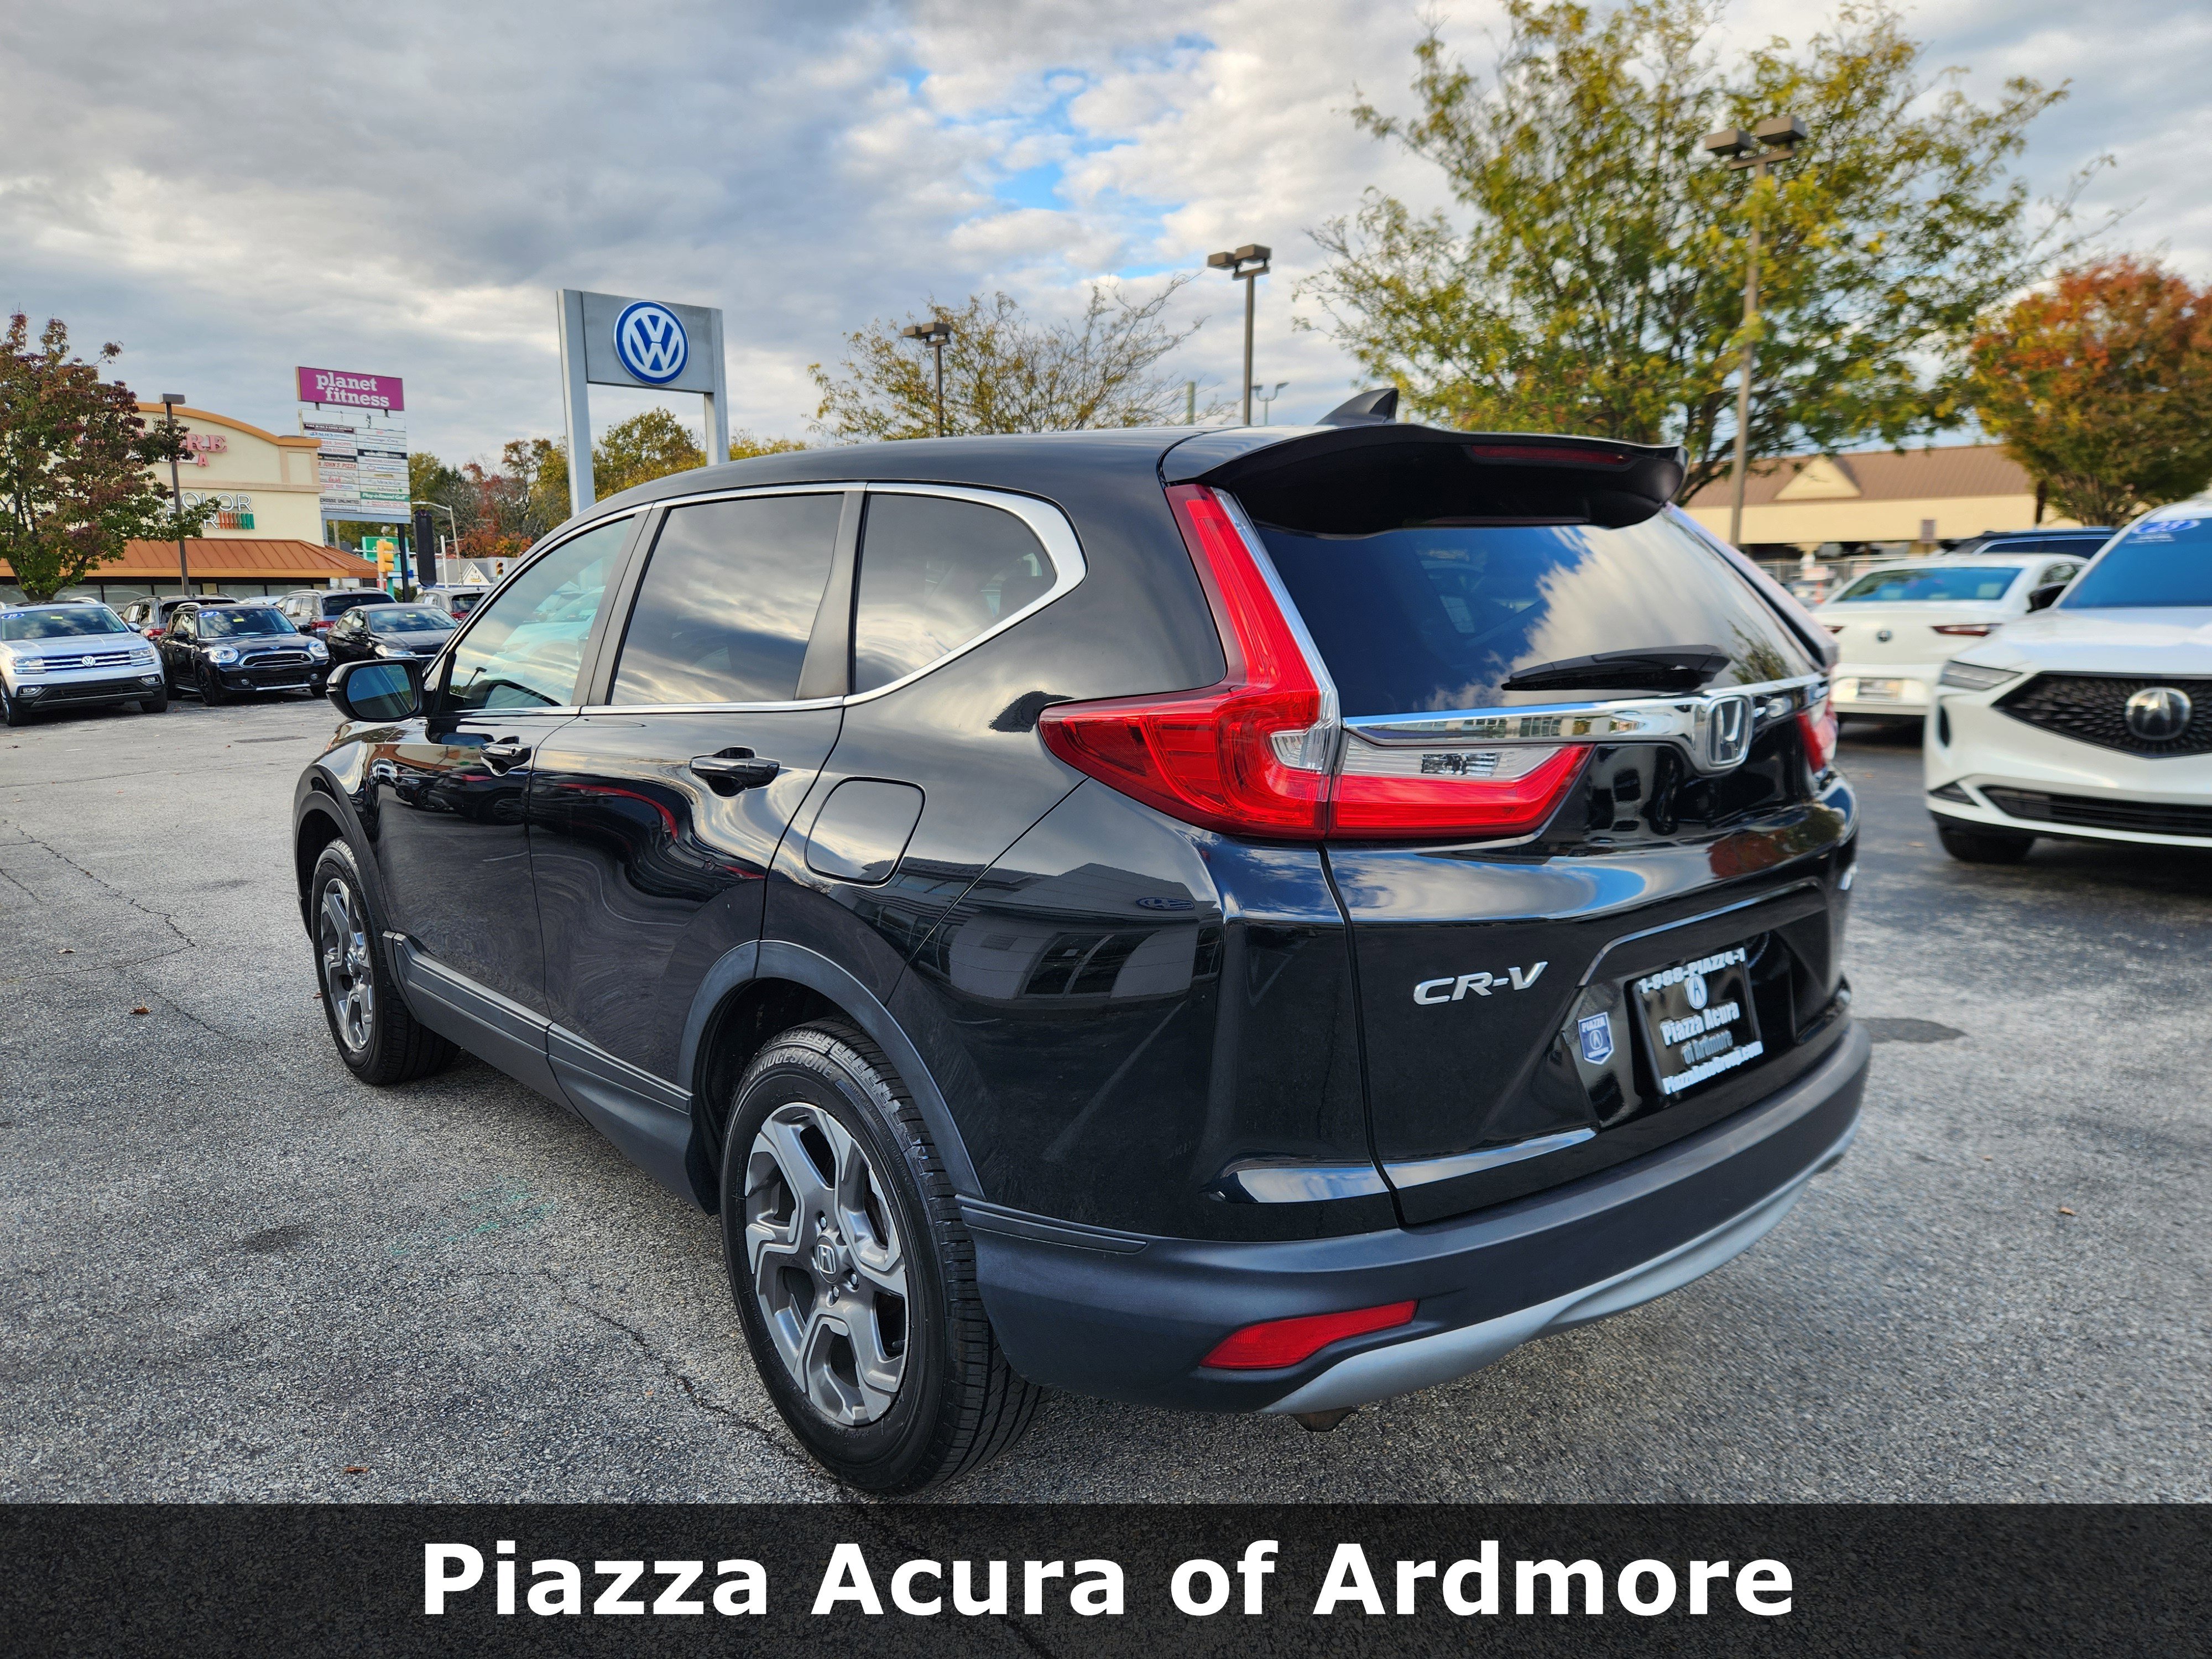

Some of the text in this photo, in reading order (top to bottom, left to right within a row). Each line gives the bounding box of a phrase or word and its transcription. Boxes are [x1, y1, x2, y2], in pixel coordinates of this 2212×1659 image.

[316, 372, 377, 392] planet
[326, 387, 390, 407] fitness
[1413, 961, 1548, 1005] CR-V
[1581, 1016, 1606, 1032] PIAZZA
[1661, 1001, 1741, 1046] Piazza Acura
[1682, 1044, 1697, 1065] of
